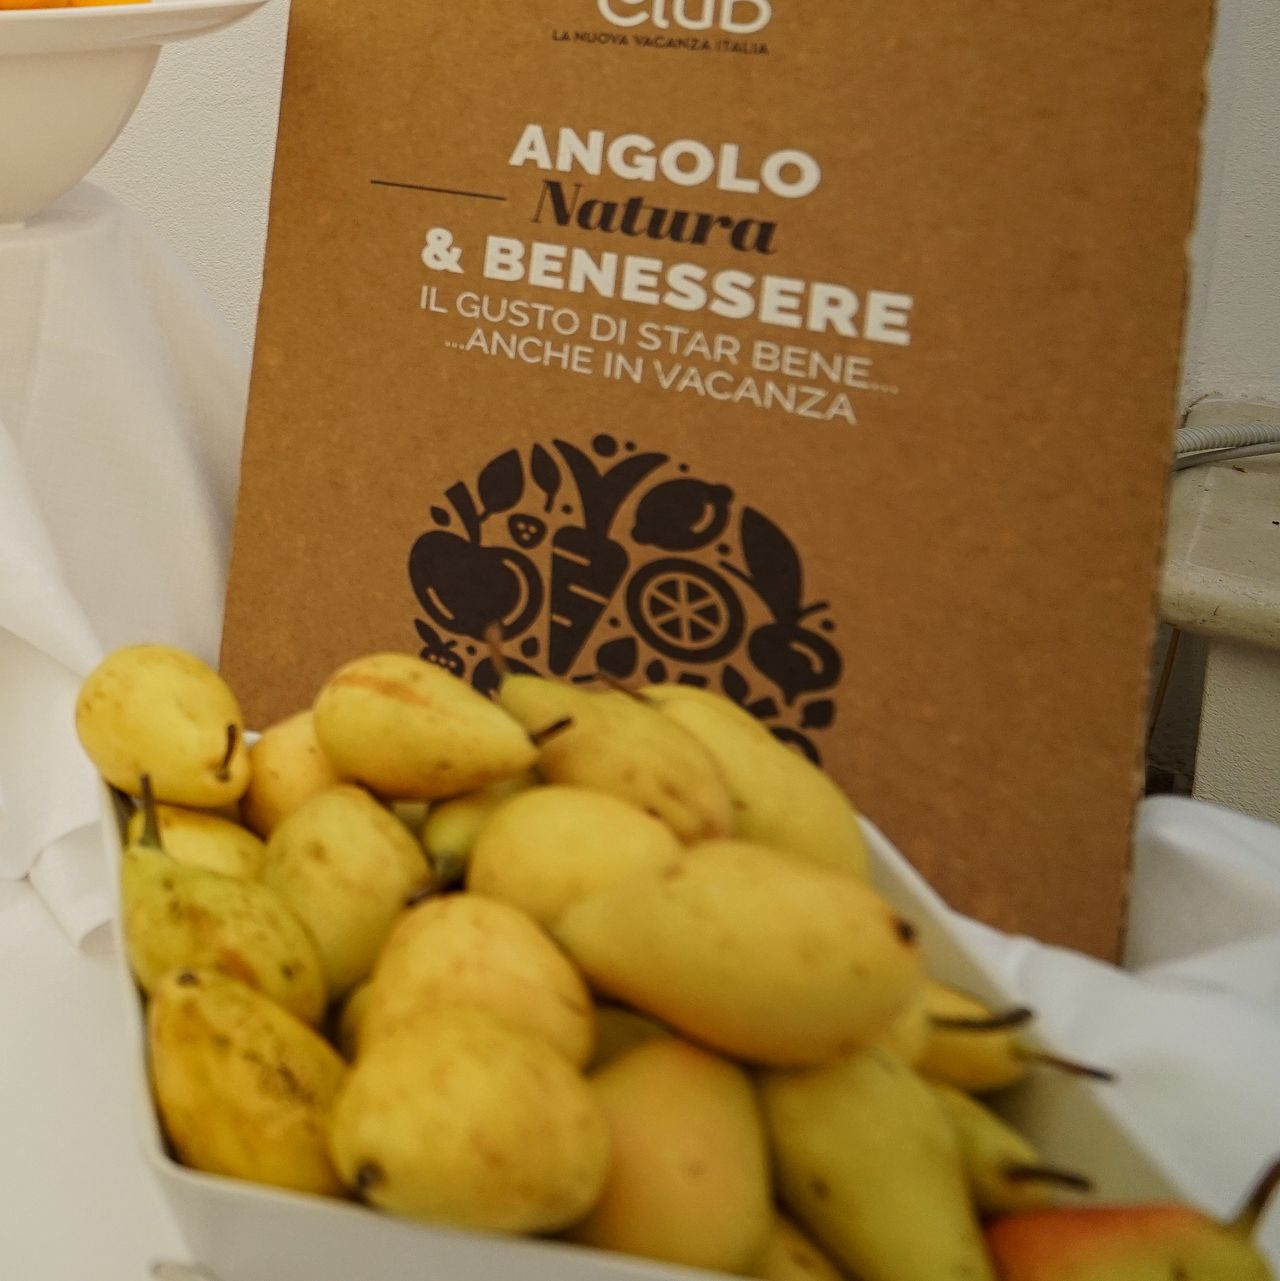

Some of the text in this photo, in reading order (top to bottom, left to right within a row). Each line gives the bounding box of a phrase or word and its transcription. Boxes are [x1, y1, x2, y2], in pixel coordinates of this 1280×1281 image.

[552, 30, 770, 56] LA NUOVA VACANZA ITALIA
[509, 123, 822, 199] ANGOLO
[532, 180, 778, 255] Natura
[421, 227, 914, 346] & BENESSERE
[420, 285, 899, 395] IL GUSTO DI STAR BENE...
[445, 327, 857, 425] ...ANCHE IN VACANZA
